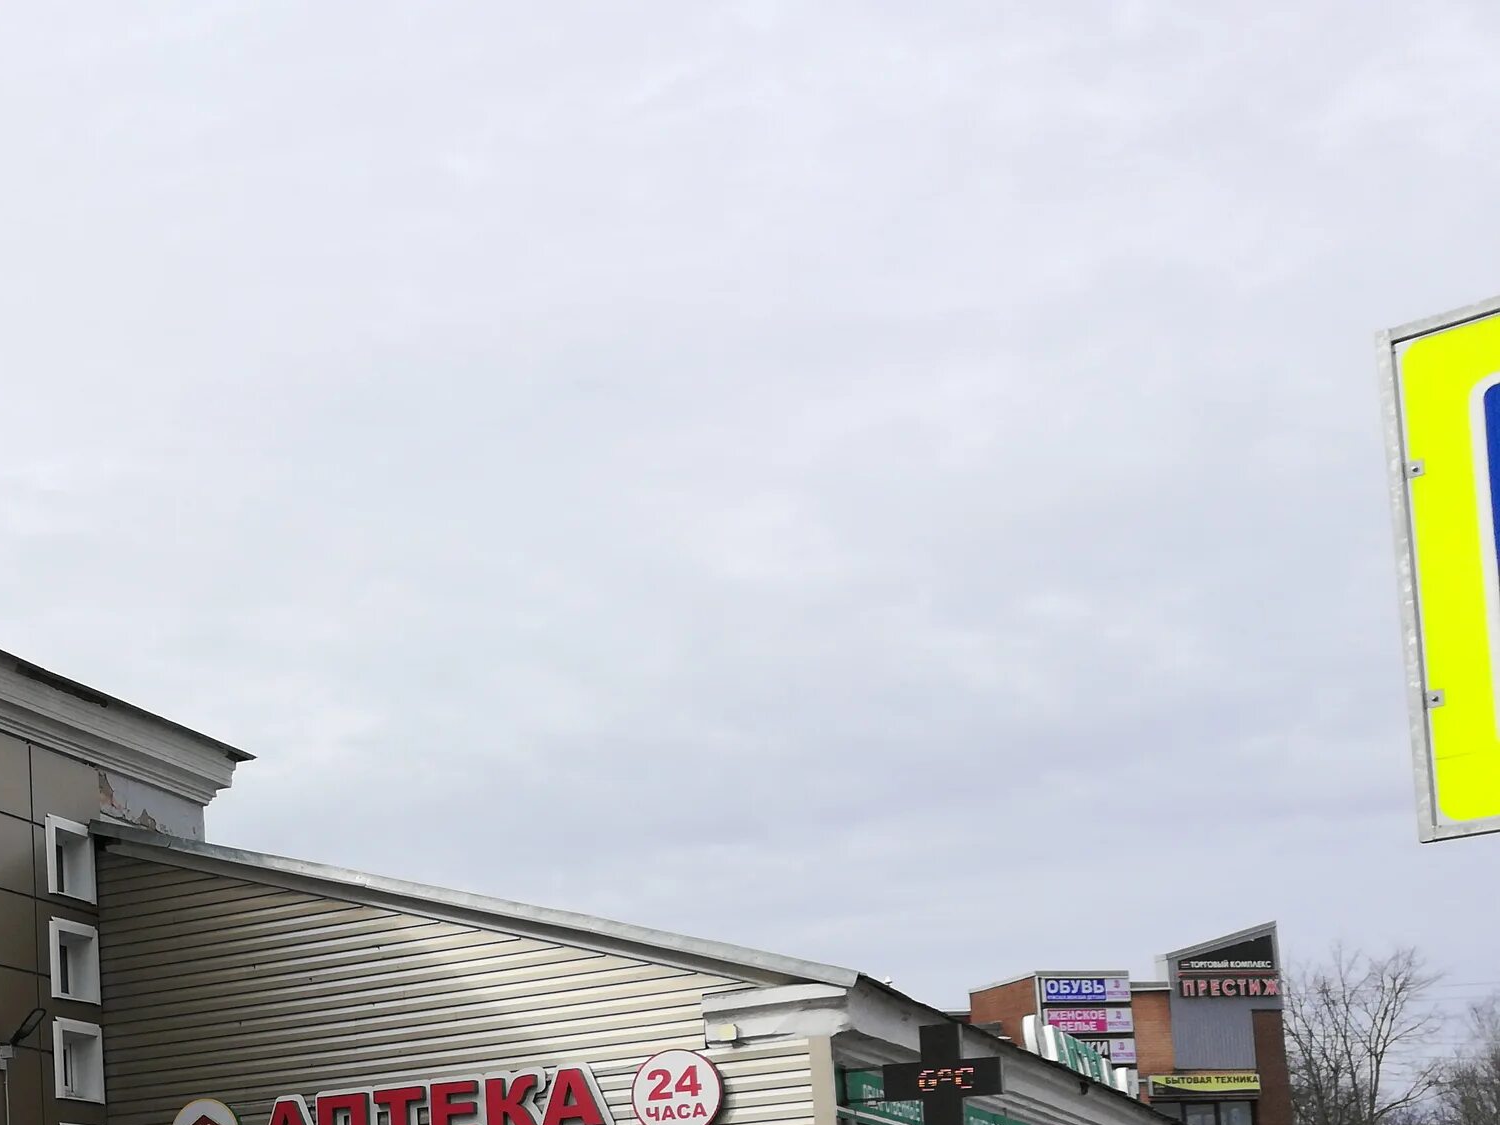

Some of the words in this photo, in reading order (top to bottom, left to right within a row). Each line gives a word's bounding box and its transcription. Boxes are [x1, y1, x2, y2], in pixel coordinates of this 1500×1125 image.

[1190, 959, 1229, 969] ТОРГОВЫЙ
[1230, 960, 1272, 969] КОМПЛЕКС
[1046, 979, 1105, 995] ОБУВЬ
[1182, 978, 1281, 997] ПРЕСТИЖ
[1048, 1009, 1106, 1021] ЖЕНСКОЕ
[1059, 1021, 1098, 1031] БЕЛЬЕ
[646, 1065, 703, 1101] 24
[1165, 1077, 1212, 1085] БЫТОВАЯ
[1215, 1076, 1259, 1084] ТЕХНИКА
[645, 1101, 709, 1123] ЧАСА
